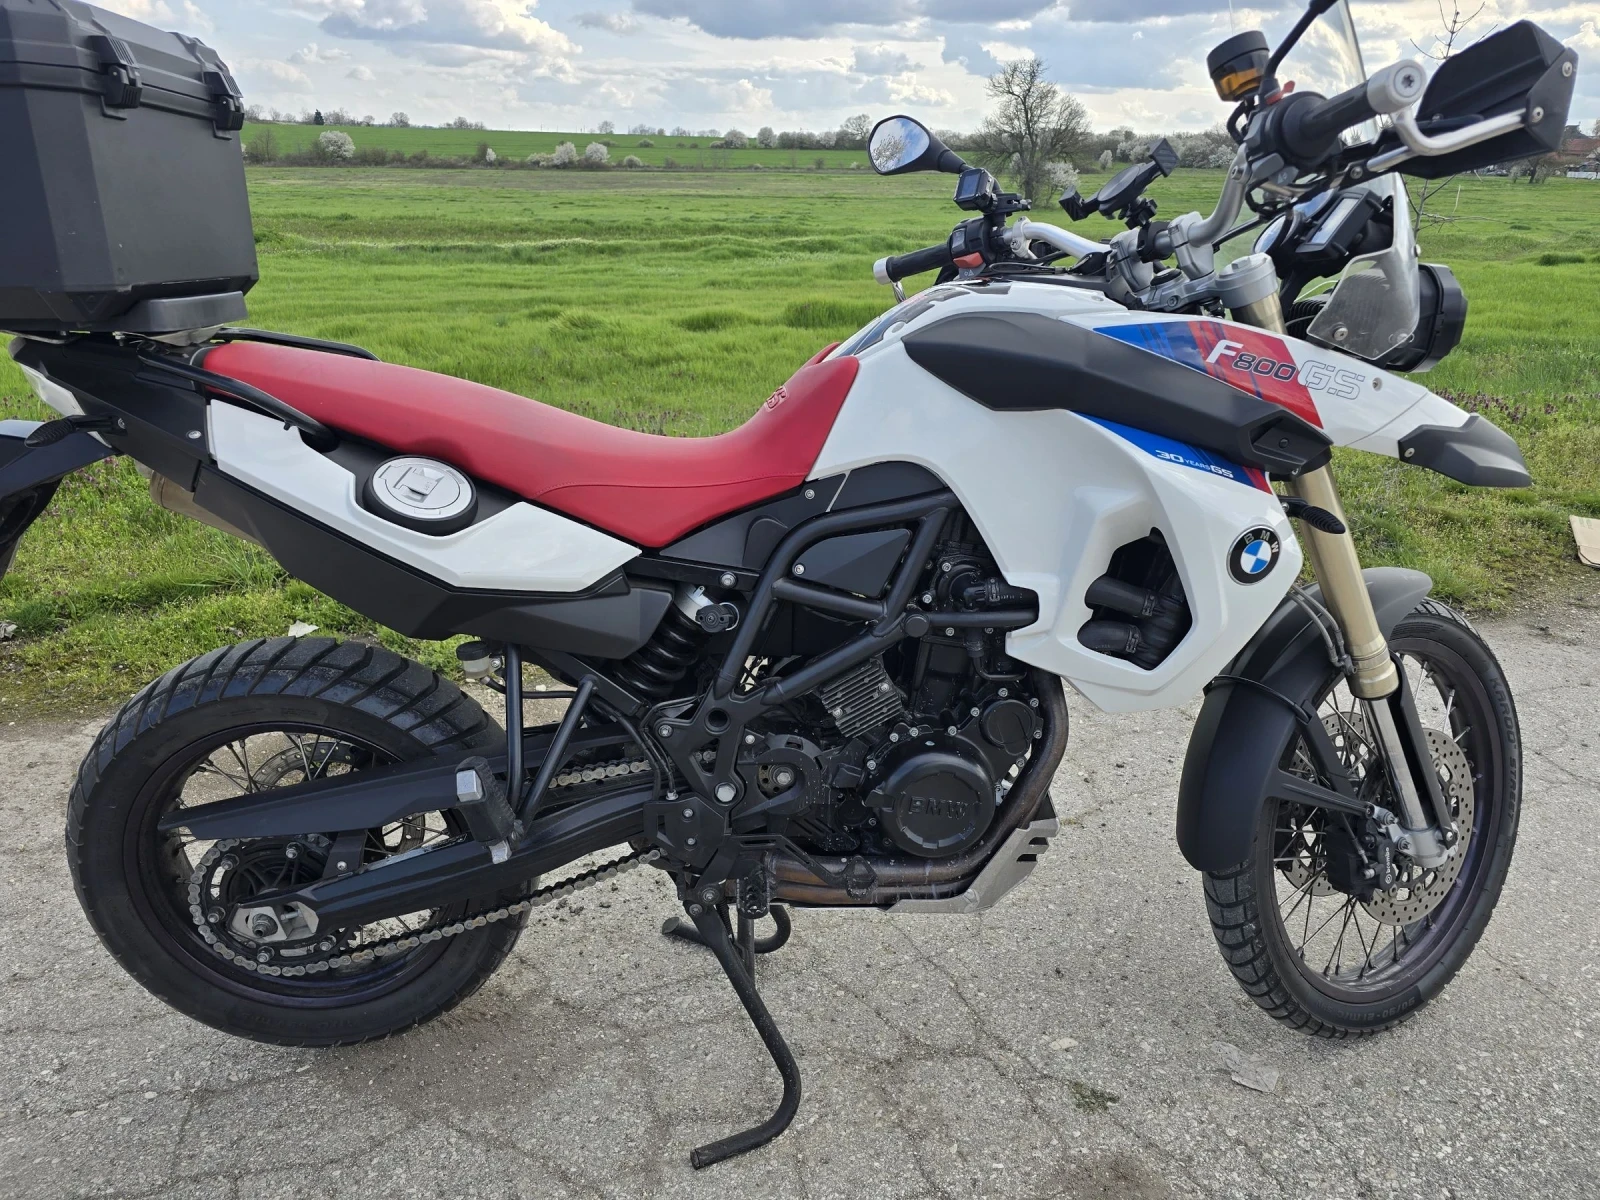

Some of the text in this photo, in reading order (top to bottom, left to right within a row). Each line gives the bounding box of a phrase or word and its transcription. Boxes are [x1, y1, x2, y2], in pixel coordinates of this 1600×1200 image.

[1155, 449, 1234, 479] 30 YEARS GS
[1243, 530, 1279, 554] BMW
[1507, 756, 1518, 824] STREET
[908, 795, 969, 819] BMW
